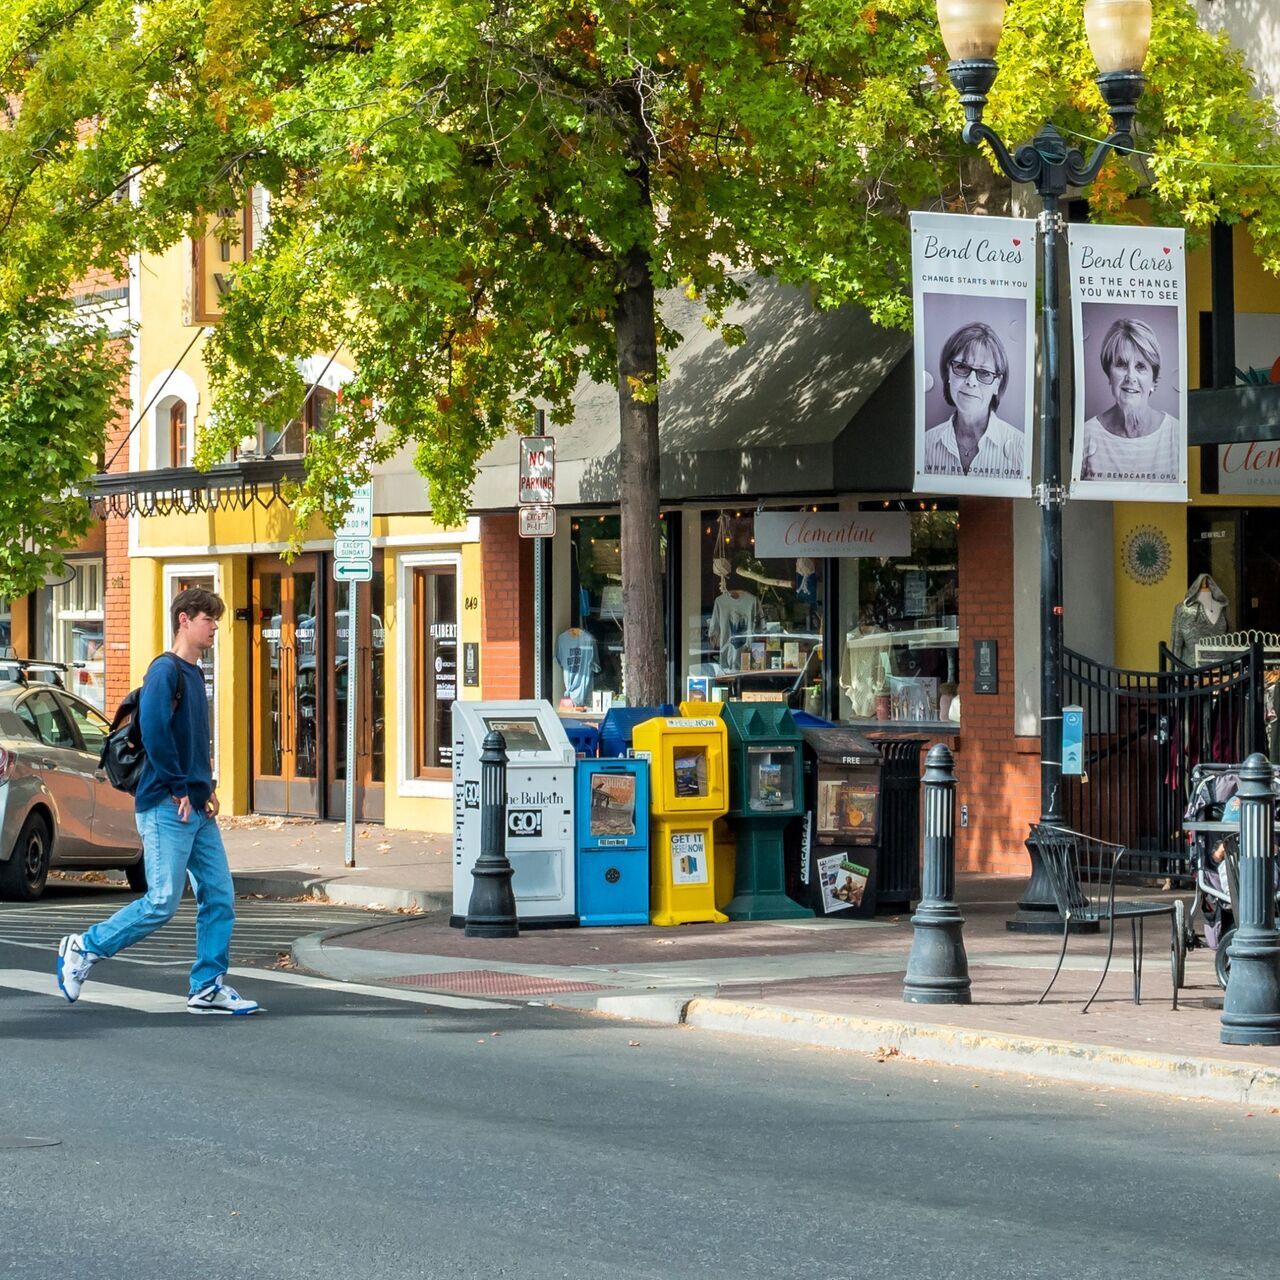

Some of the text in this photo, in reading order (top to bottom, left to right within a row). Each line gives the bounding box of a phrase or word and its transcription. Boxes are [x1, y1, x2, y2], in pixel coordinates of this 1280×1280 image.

[924, 235, 1024, 264] Bend Cares
[1081, 246, 1175, 271] Bend Cares
[922, 274, 1028, 288] CHANGE STARTS WITH YOU
[1079, 276, 1179, 289] BE THE CHANGE
[1080, 288, 1179, 300] YOU WANT TO SEE
[529, 452, 545, 466] NO
[521, 477, 553, 489] PARKING
[526, 512, 548, 521] EXCEPT
[784, 518, 878, 546] Clementine
[465, 597, 478, 610] 849
[842, 756, 860, 765] FREE
[601, 777, 631, 789] SOURCE
[465, 783, 480, 803] GO!
[521, 791, 563, 805] Bulletin
[456, 734, 465, 866] The Bulletin
[508, 812, 541, 831] GO!
[671, 834, 702, 844] GET IT
[687, 844, 703, 853] NOW
